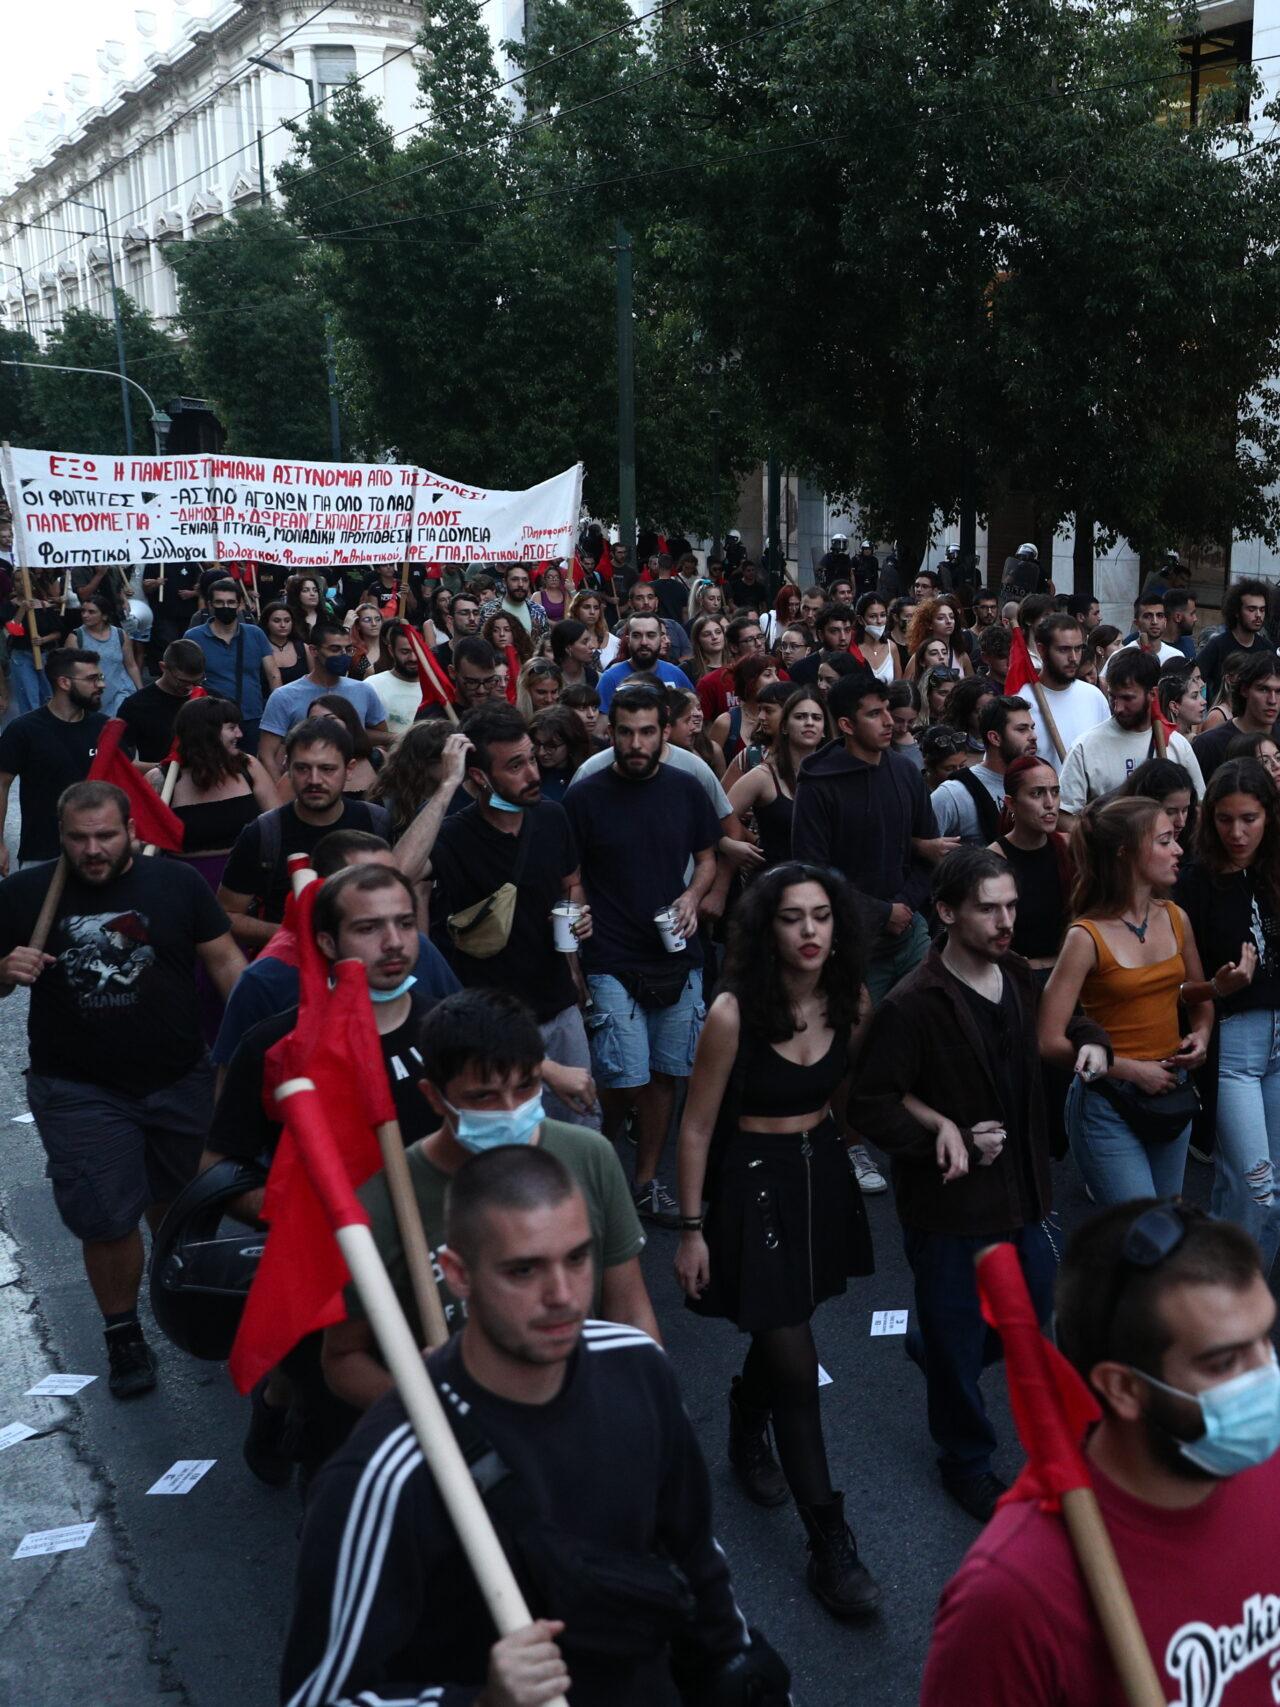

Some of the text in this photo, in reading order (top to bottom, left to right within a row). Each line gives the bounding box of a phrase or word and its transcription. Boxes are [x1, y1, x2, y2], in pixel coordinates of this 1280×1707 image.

[50, 455, 98, 480] ΕΞΩ
[114, 462, 124, 481] Η
[131, 458, 265, 483] ΠΑΝΕΠΙΣΤΗΜΙΑΚΗ
[273, 465, 362, 487] ΑΣΤΥΝΟΜΙΑ
[368, 470, 393, 487] ΑΠΟ
[400, 470, 418, 486] ΤΙΣ
[23, 490, 135, 508] ΟΙ ΦΟΙΤΗΤΕΣ
[245, 491, 307, 511] ΑΓΩΝΩΝ
[313, 495, 331, 511] ΓΙΑ
[336, 495, 362, 511] ΟΛΟ
[368, 496, 384, 511] ΤΟ
[387, 494, 414, 511] ΛΑΟ
[26, 512, 149, 533] ΠΑΛΕΥΟΥΜΕ ΓΙΑ
[394, 512, 411, 528] ΓΙΑ
[417, 510, 461, 526] ΟΛΟΥΣ
[418, 528, 435, 542] ΓΙΑ
[439, 527, 491, 542] ΔΟΥΛΕΙΑ
